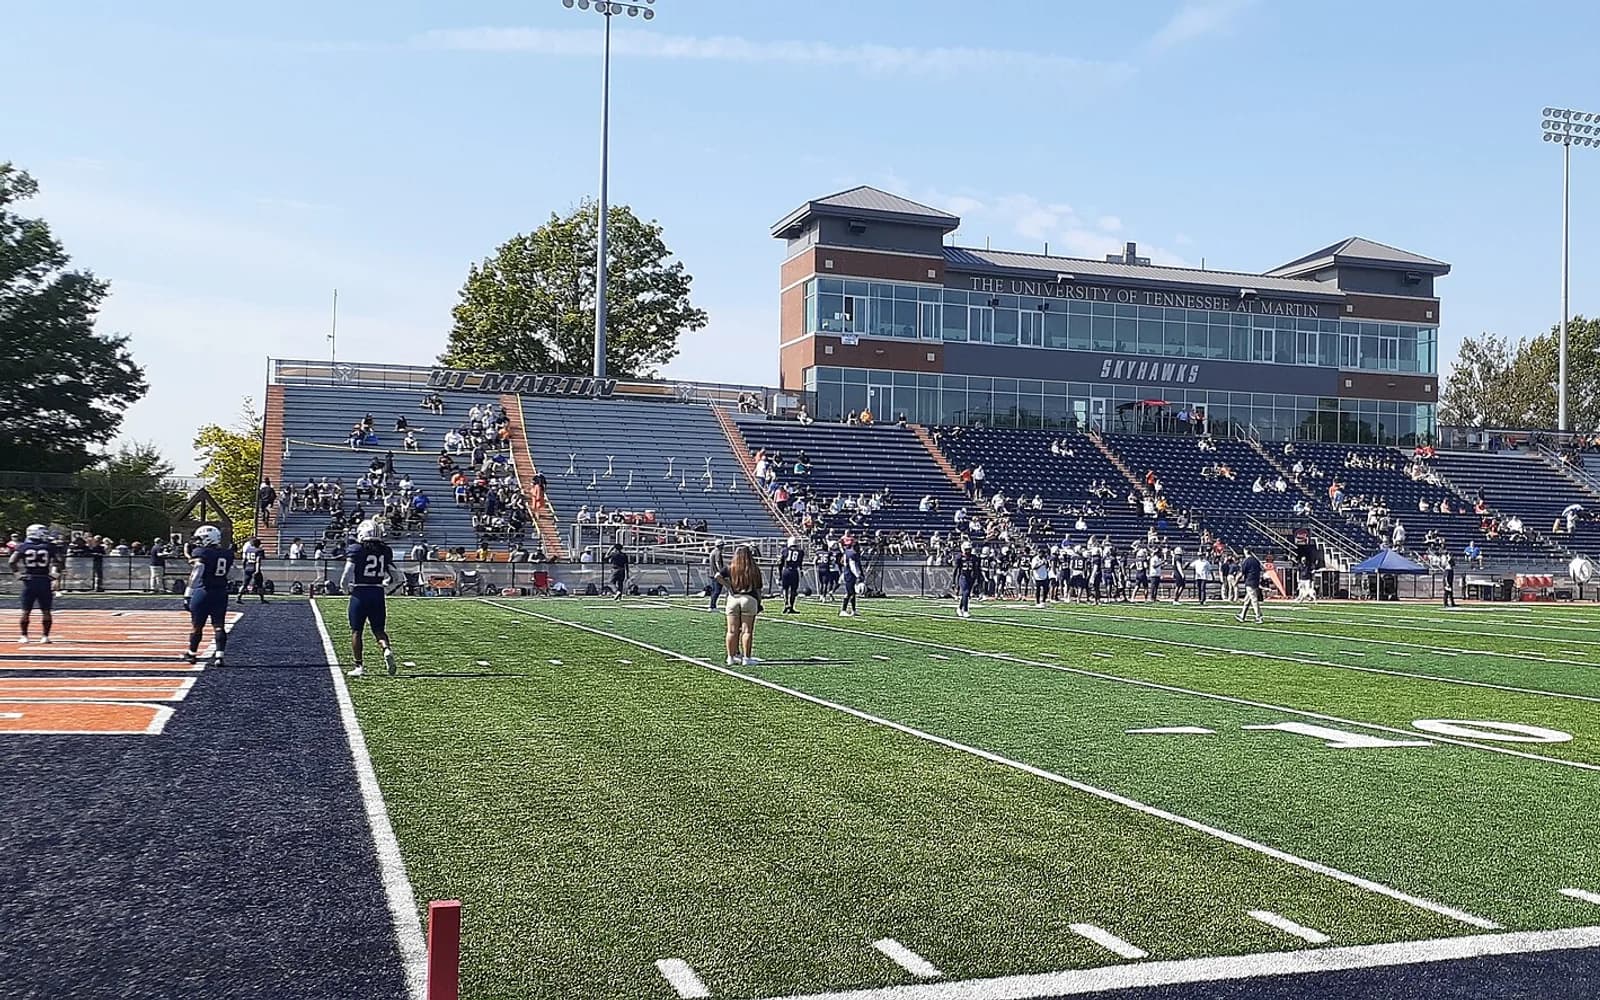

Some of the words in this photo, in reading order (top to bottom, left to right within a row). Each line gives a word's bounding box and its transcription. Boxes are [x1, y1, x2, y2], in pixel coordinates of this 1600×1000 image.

[969, 276, 1004, 292] THE
[1011, 280, 1112, 302] UNIVERSITY
[1117, 289, 1138, 303] OF
[1143, 291, 1230, 311] TENNESSEE
[1236, 299, 1256, 313] AT
[1261, 300, 1320, 317] MARTIN
[425, 368, 472, 389] UT
[479, 371, 618, 397] MARTIN
[1100, 359, 1200, 383] SKYHAWKS
[24, 548, 49, 568] 23
[215, 557, 227, 576] 8
[363, 554, 386, 577] 21
[787, 550, 799, 561] 18
[1241, 719, 1574, 749] 10
